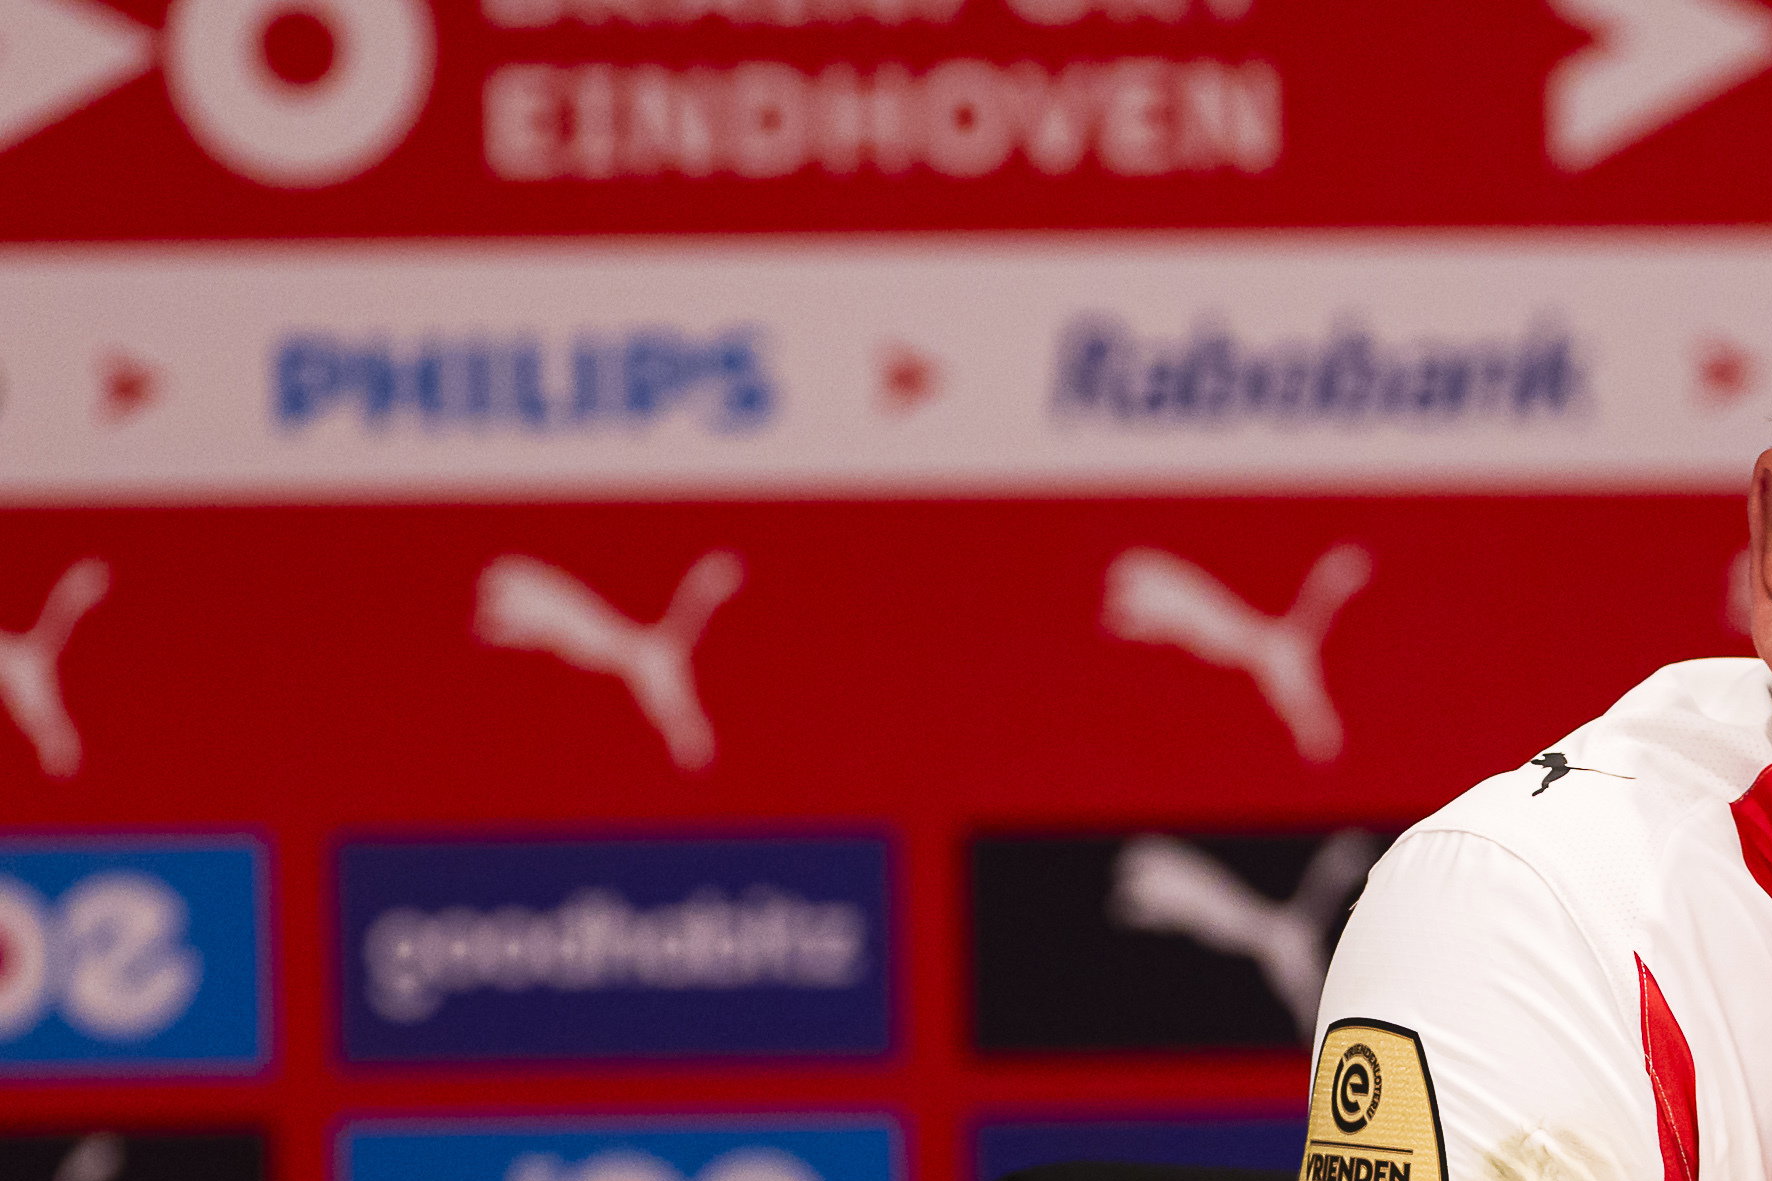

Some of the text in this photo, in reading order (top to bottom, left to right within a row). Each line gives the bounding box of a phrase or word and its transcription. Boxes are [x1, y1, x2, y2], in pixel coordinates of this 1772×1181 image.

[485, 59, 1281, 180] EINDHOVEN
[273, 326, 775, 436] PHILIPS
[1053, 308, 1588, 430] Rabobank
